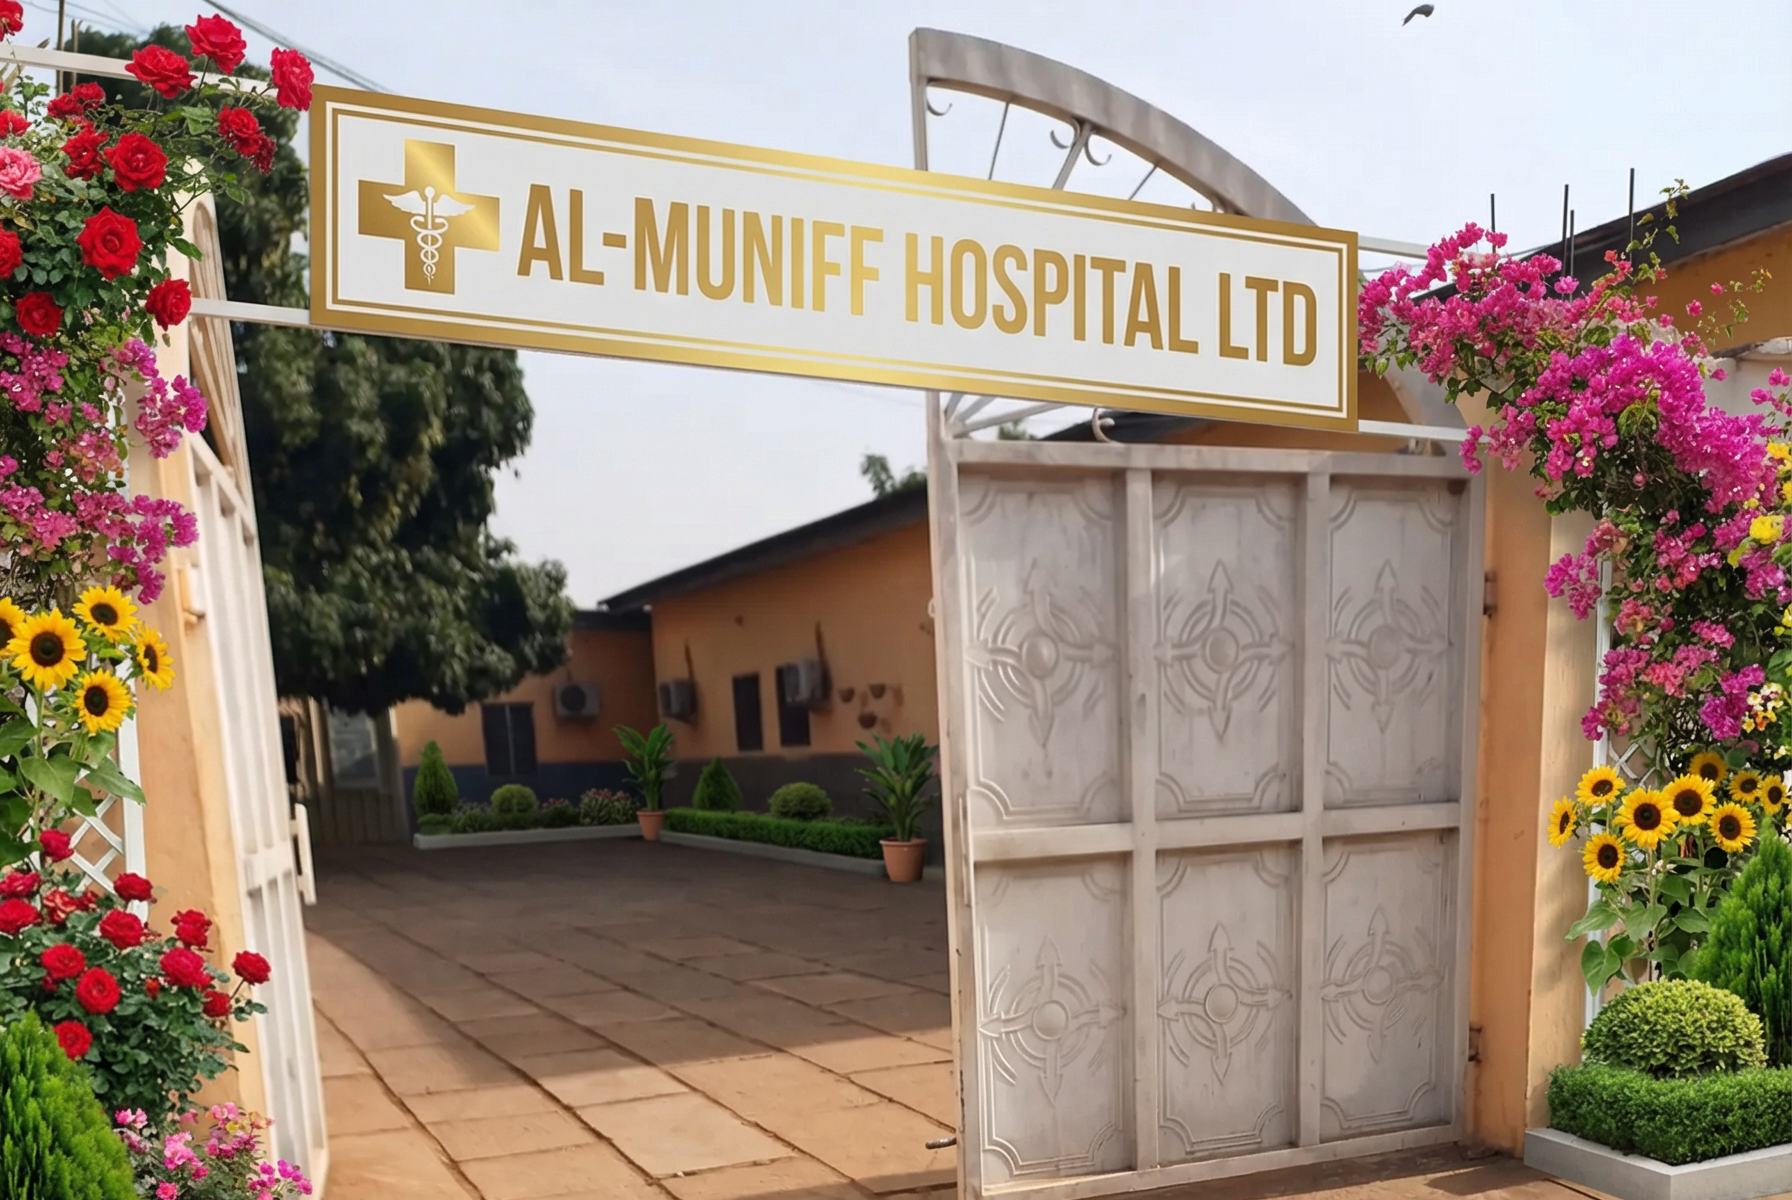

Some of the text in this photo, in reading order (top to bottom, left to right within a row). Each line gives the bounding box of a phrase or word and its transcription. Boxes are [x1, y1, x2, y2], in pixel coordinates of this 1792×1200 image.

[516, 183, 1318, 367] AL-MUNIFF HOSPITAL LTD
